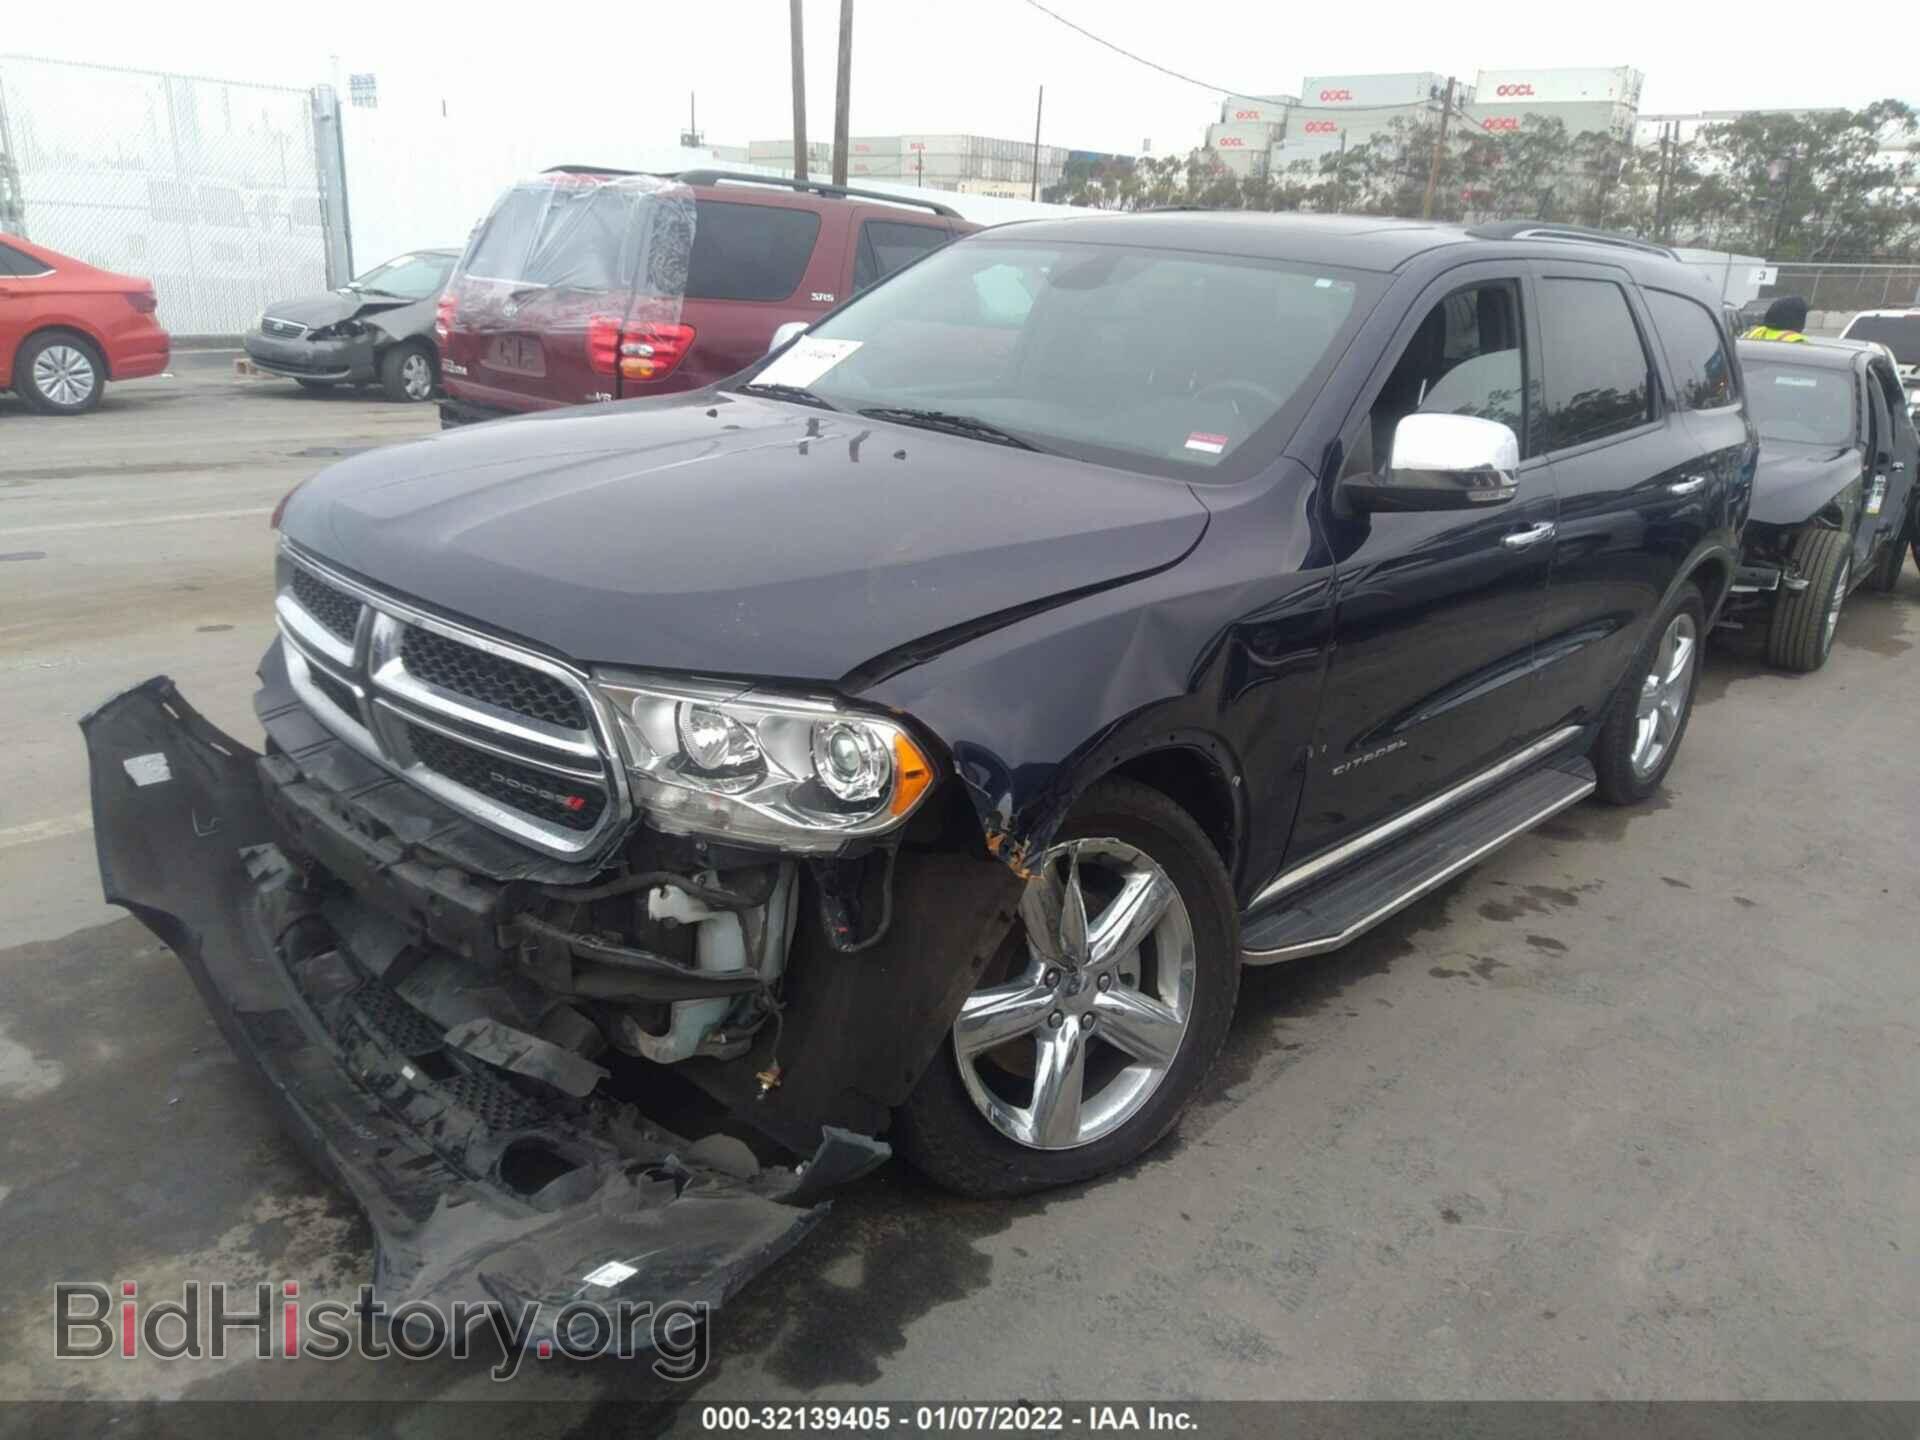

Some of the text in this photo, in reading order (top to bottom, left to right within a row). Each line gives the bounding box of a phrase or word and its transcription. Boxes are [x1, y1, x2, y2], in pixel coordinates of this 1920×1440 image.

[1320, 89, 1353, 102] OOCL
[1497, 84, 1535, 97] OOCL
[1236, 111, 1260, 120] OOCL
[1305, 119, 1338, 133] OOCL
[1482, 117, 1520, 130] OOCL
[1219, 137, 1245, 147] OOCL
[1332, 740, 1408, 776] CITADEL
[490, 771, 568, 805] DODGE
